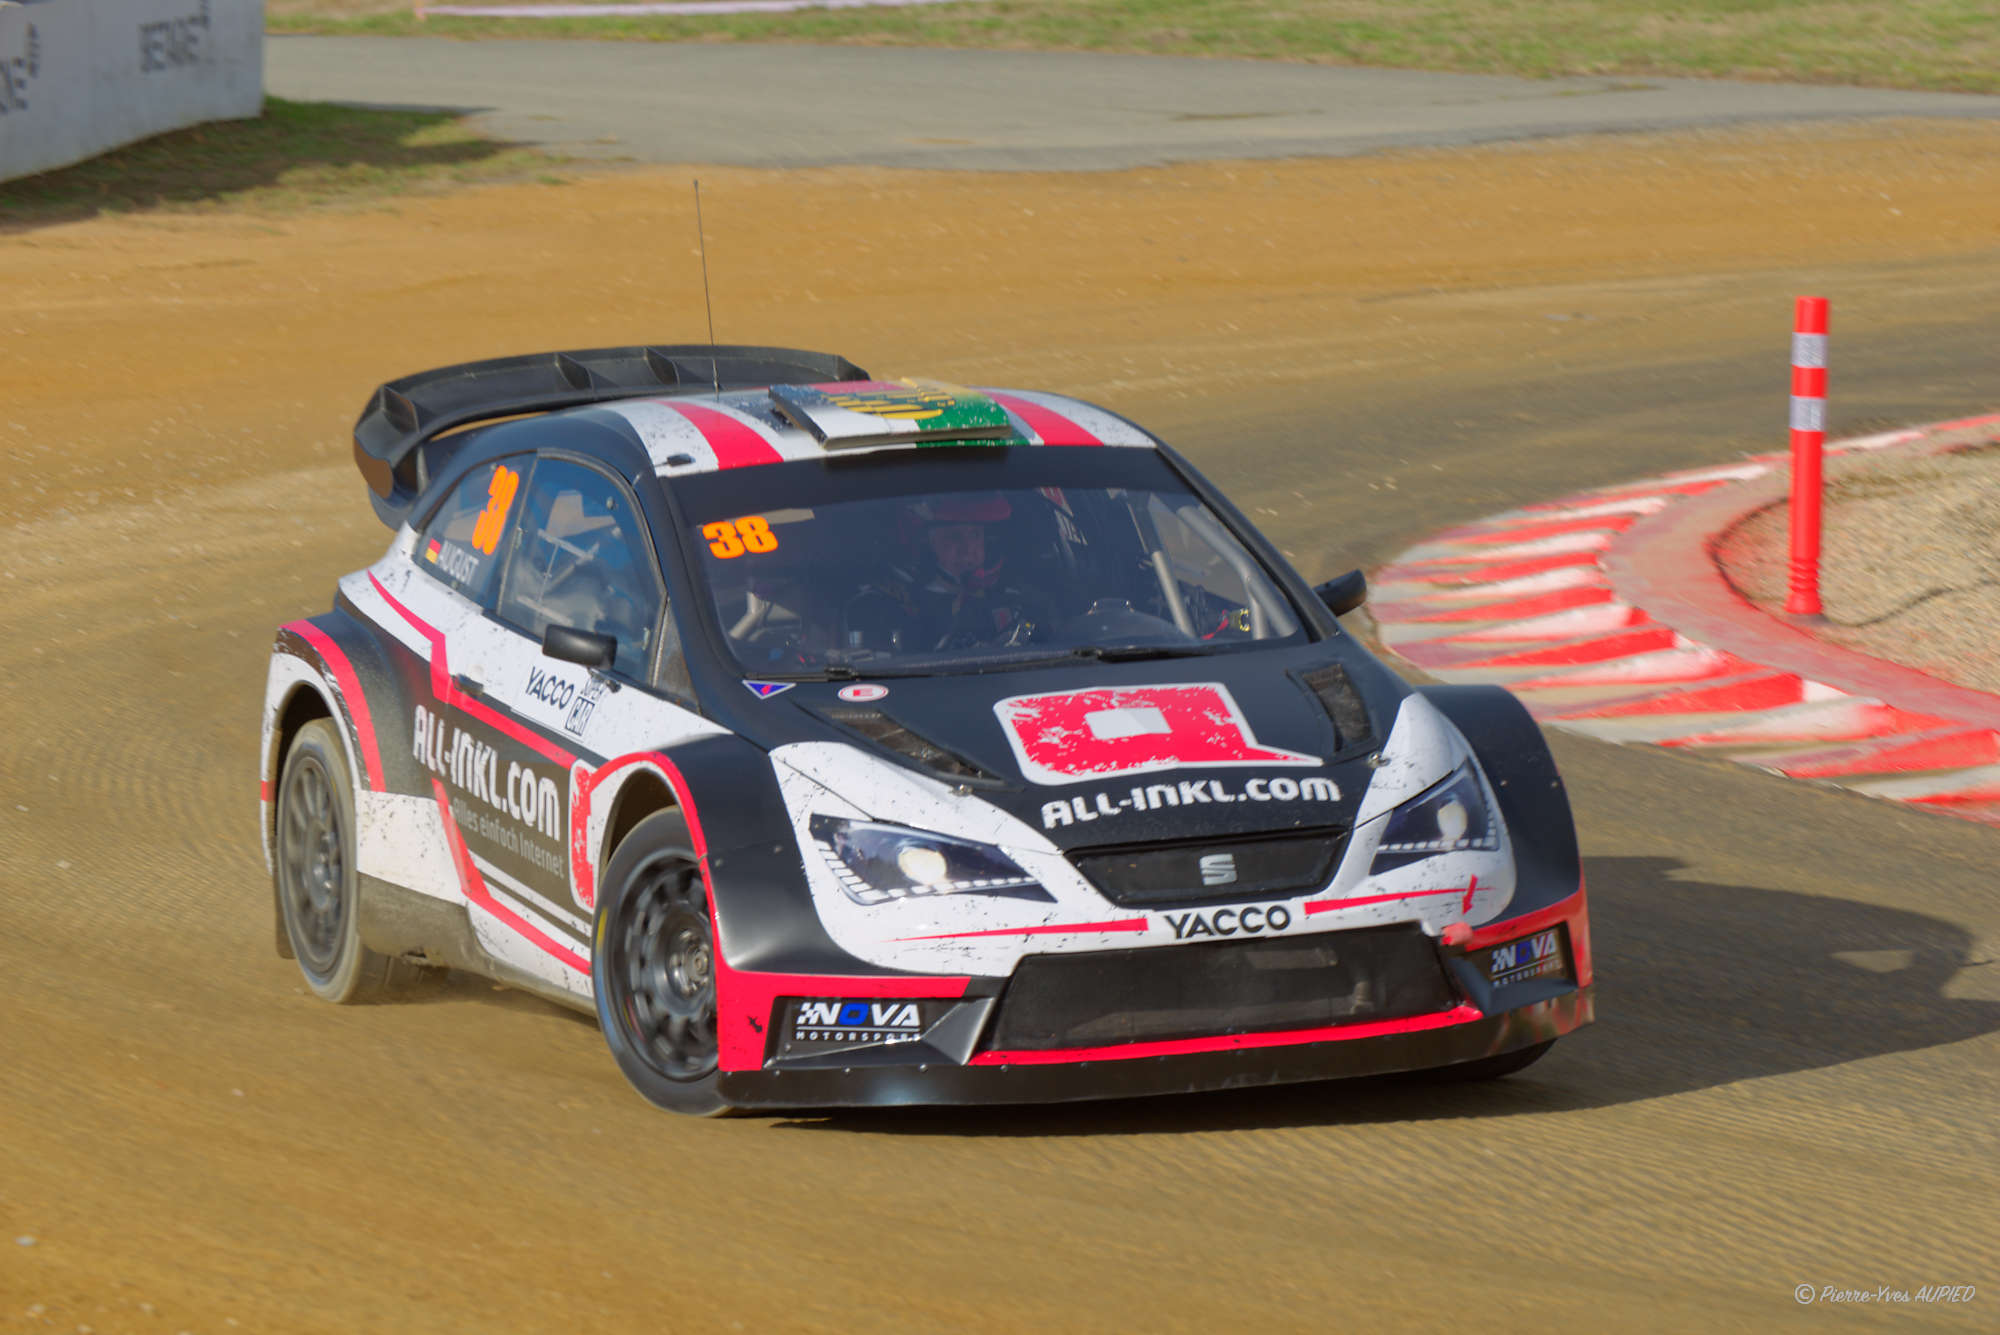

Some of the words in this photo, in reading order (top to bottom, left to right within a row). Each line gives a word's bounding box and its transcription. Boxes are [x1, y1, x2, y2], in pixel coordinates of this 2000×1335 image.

[702, 515, 779, 559] 38
[525, 666, 575, 710] YACCO
[519, 832, 566, 880] Internet
[1164, 905, 1291, 940] YACCO
[1491, 933, 1558, 974] NOVA
[796, 1001, 921, 1027] NOVA
